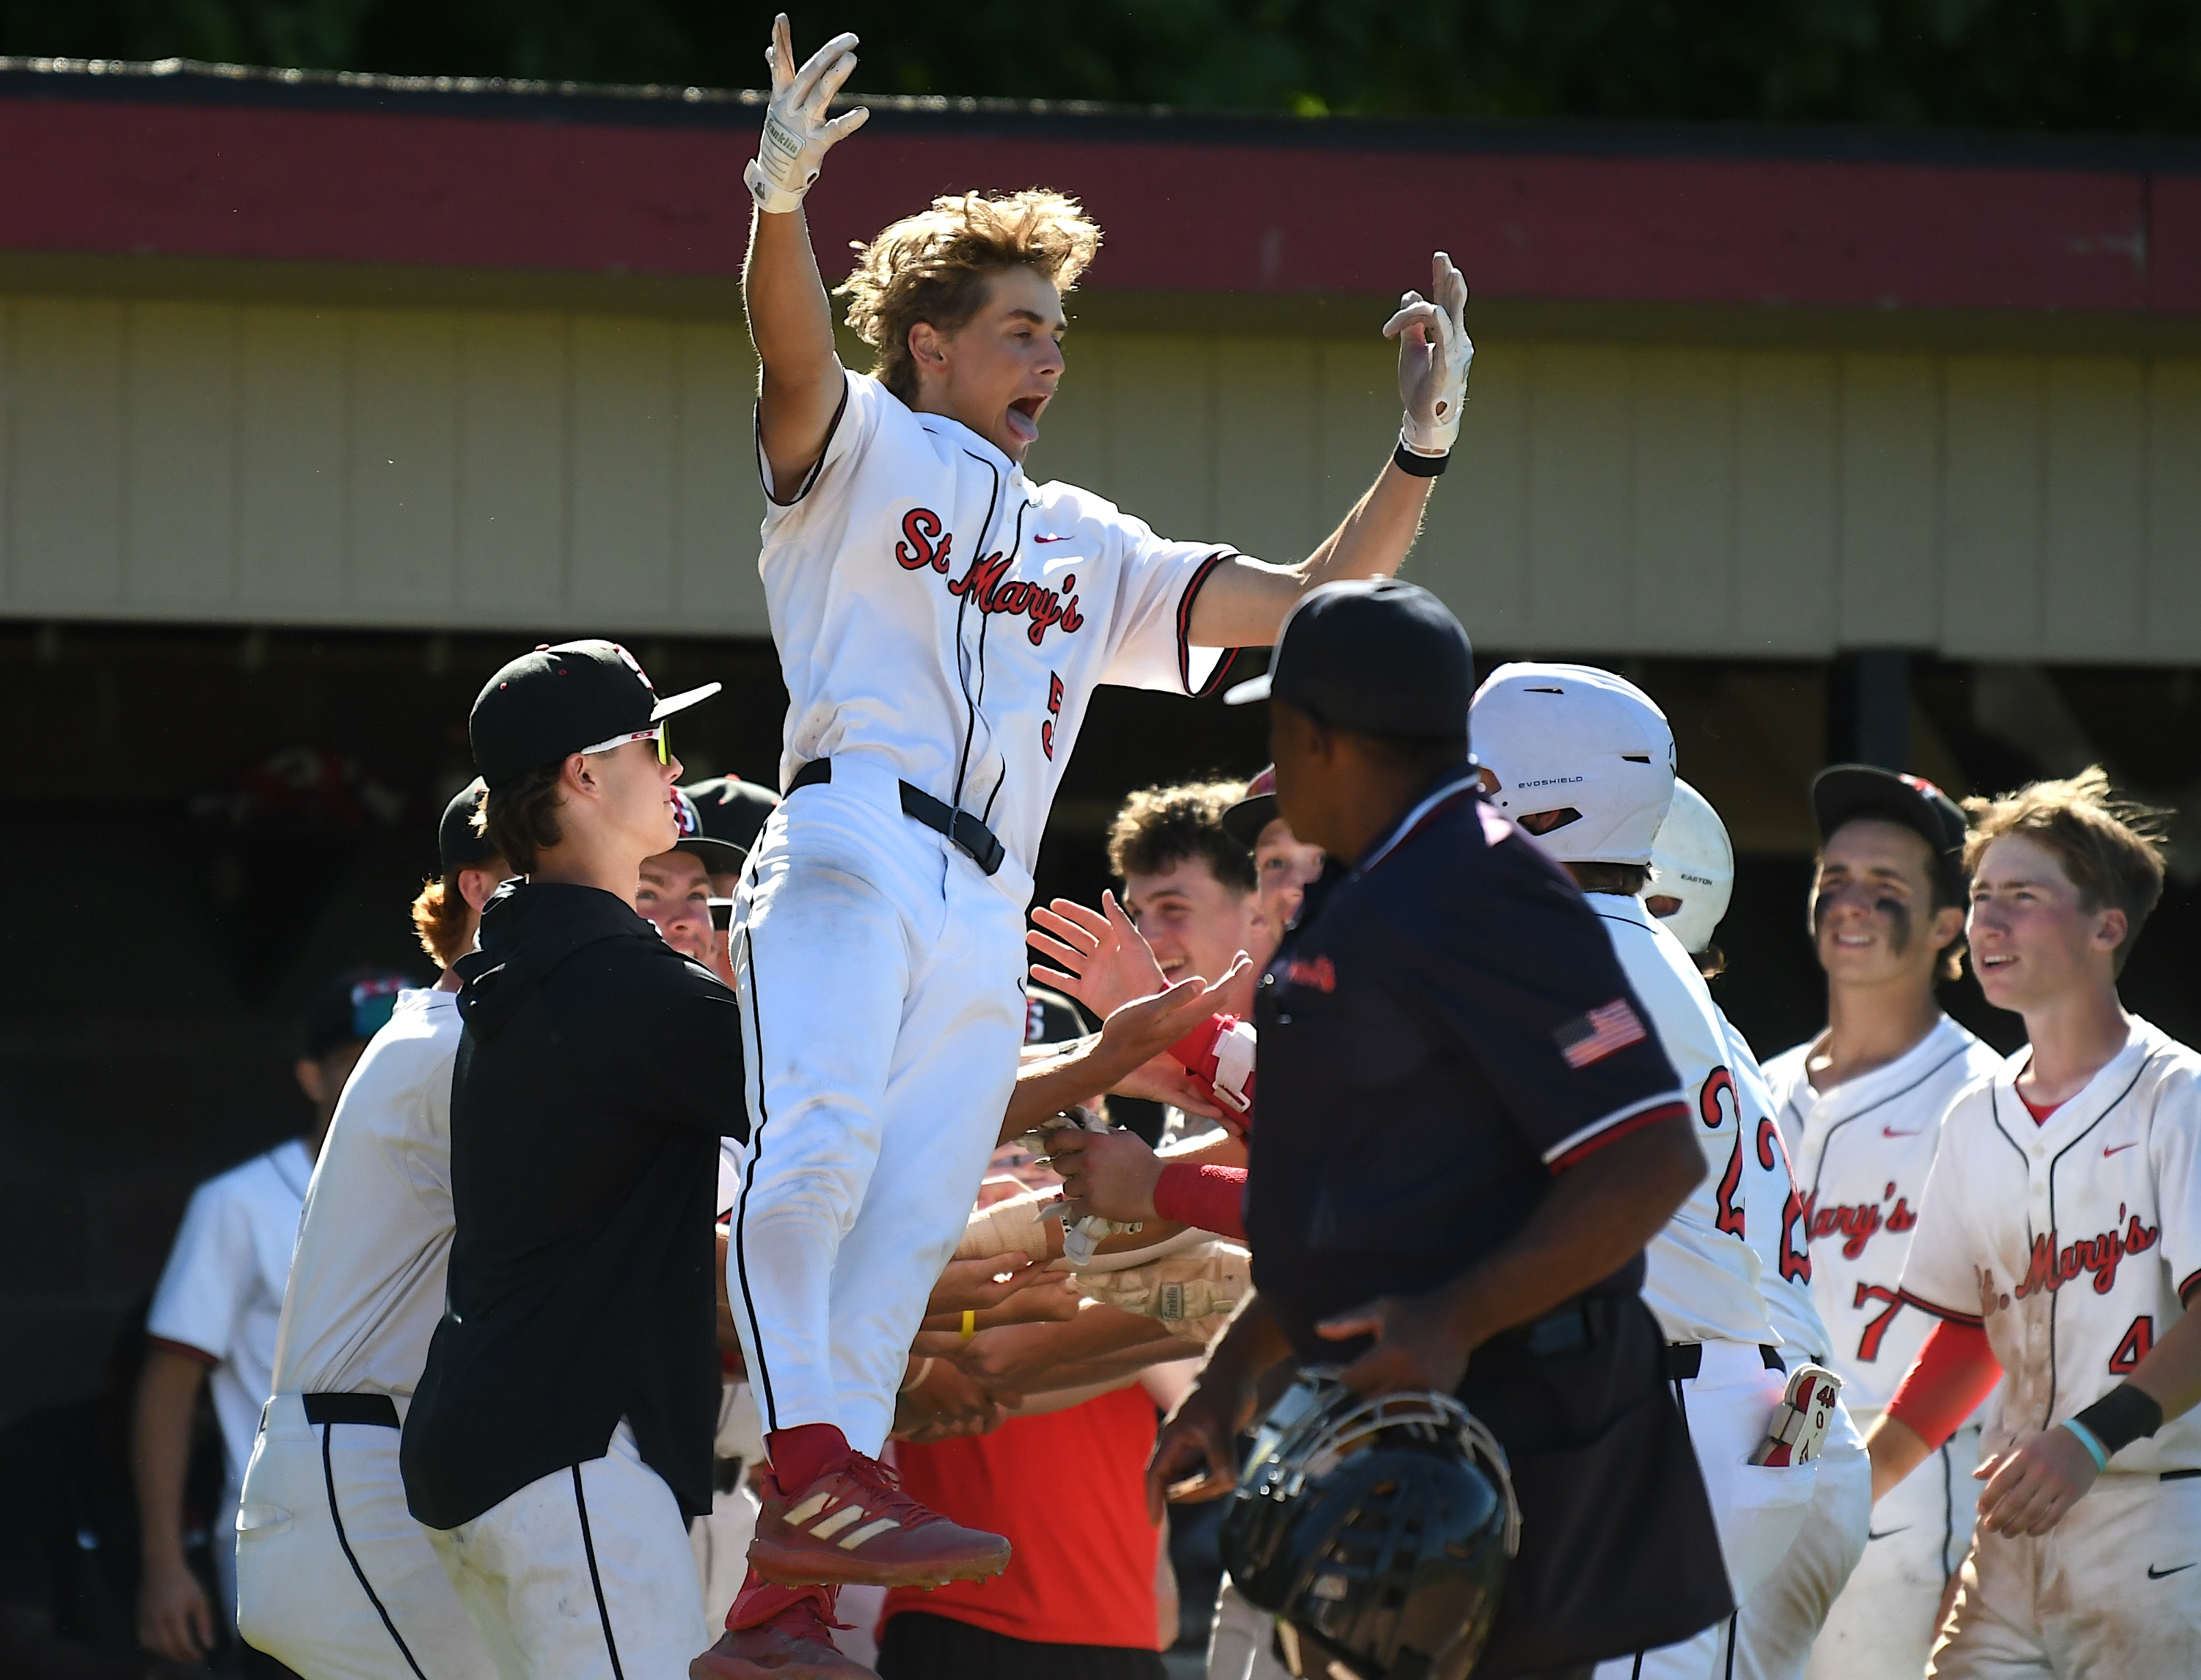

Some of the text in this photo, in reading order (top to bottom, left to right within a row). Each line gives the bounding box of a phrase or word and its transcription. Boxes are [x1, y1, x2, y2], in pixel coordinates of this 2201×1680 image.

[948, 550, 1084, 646] Mary's
[1681, 874, 1713, 885] EASTON
[2015, 1202, 2158, 1300] Mary's
[1853, 1282, 1909, 1363] 7
[2109, 1315, 2154, 1376] 4
